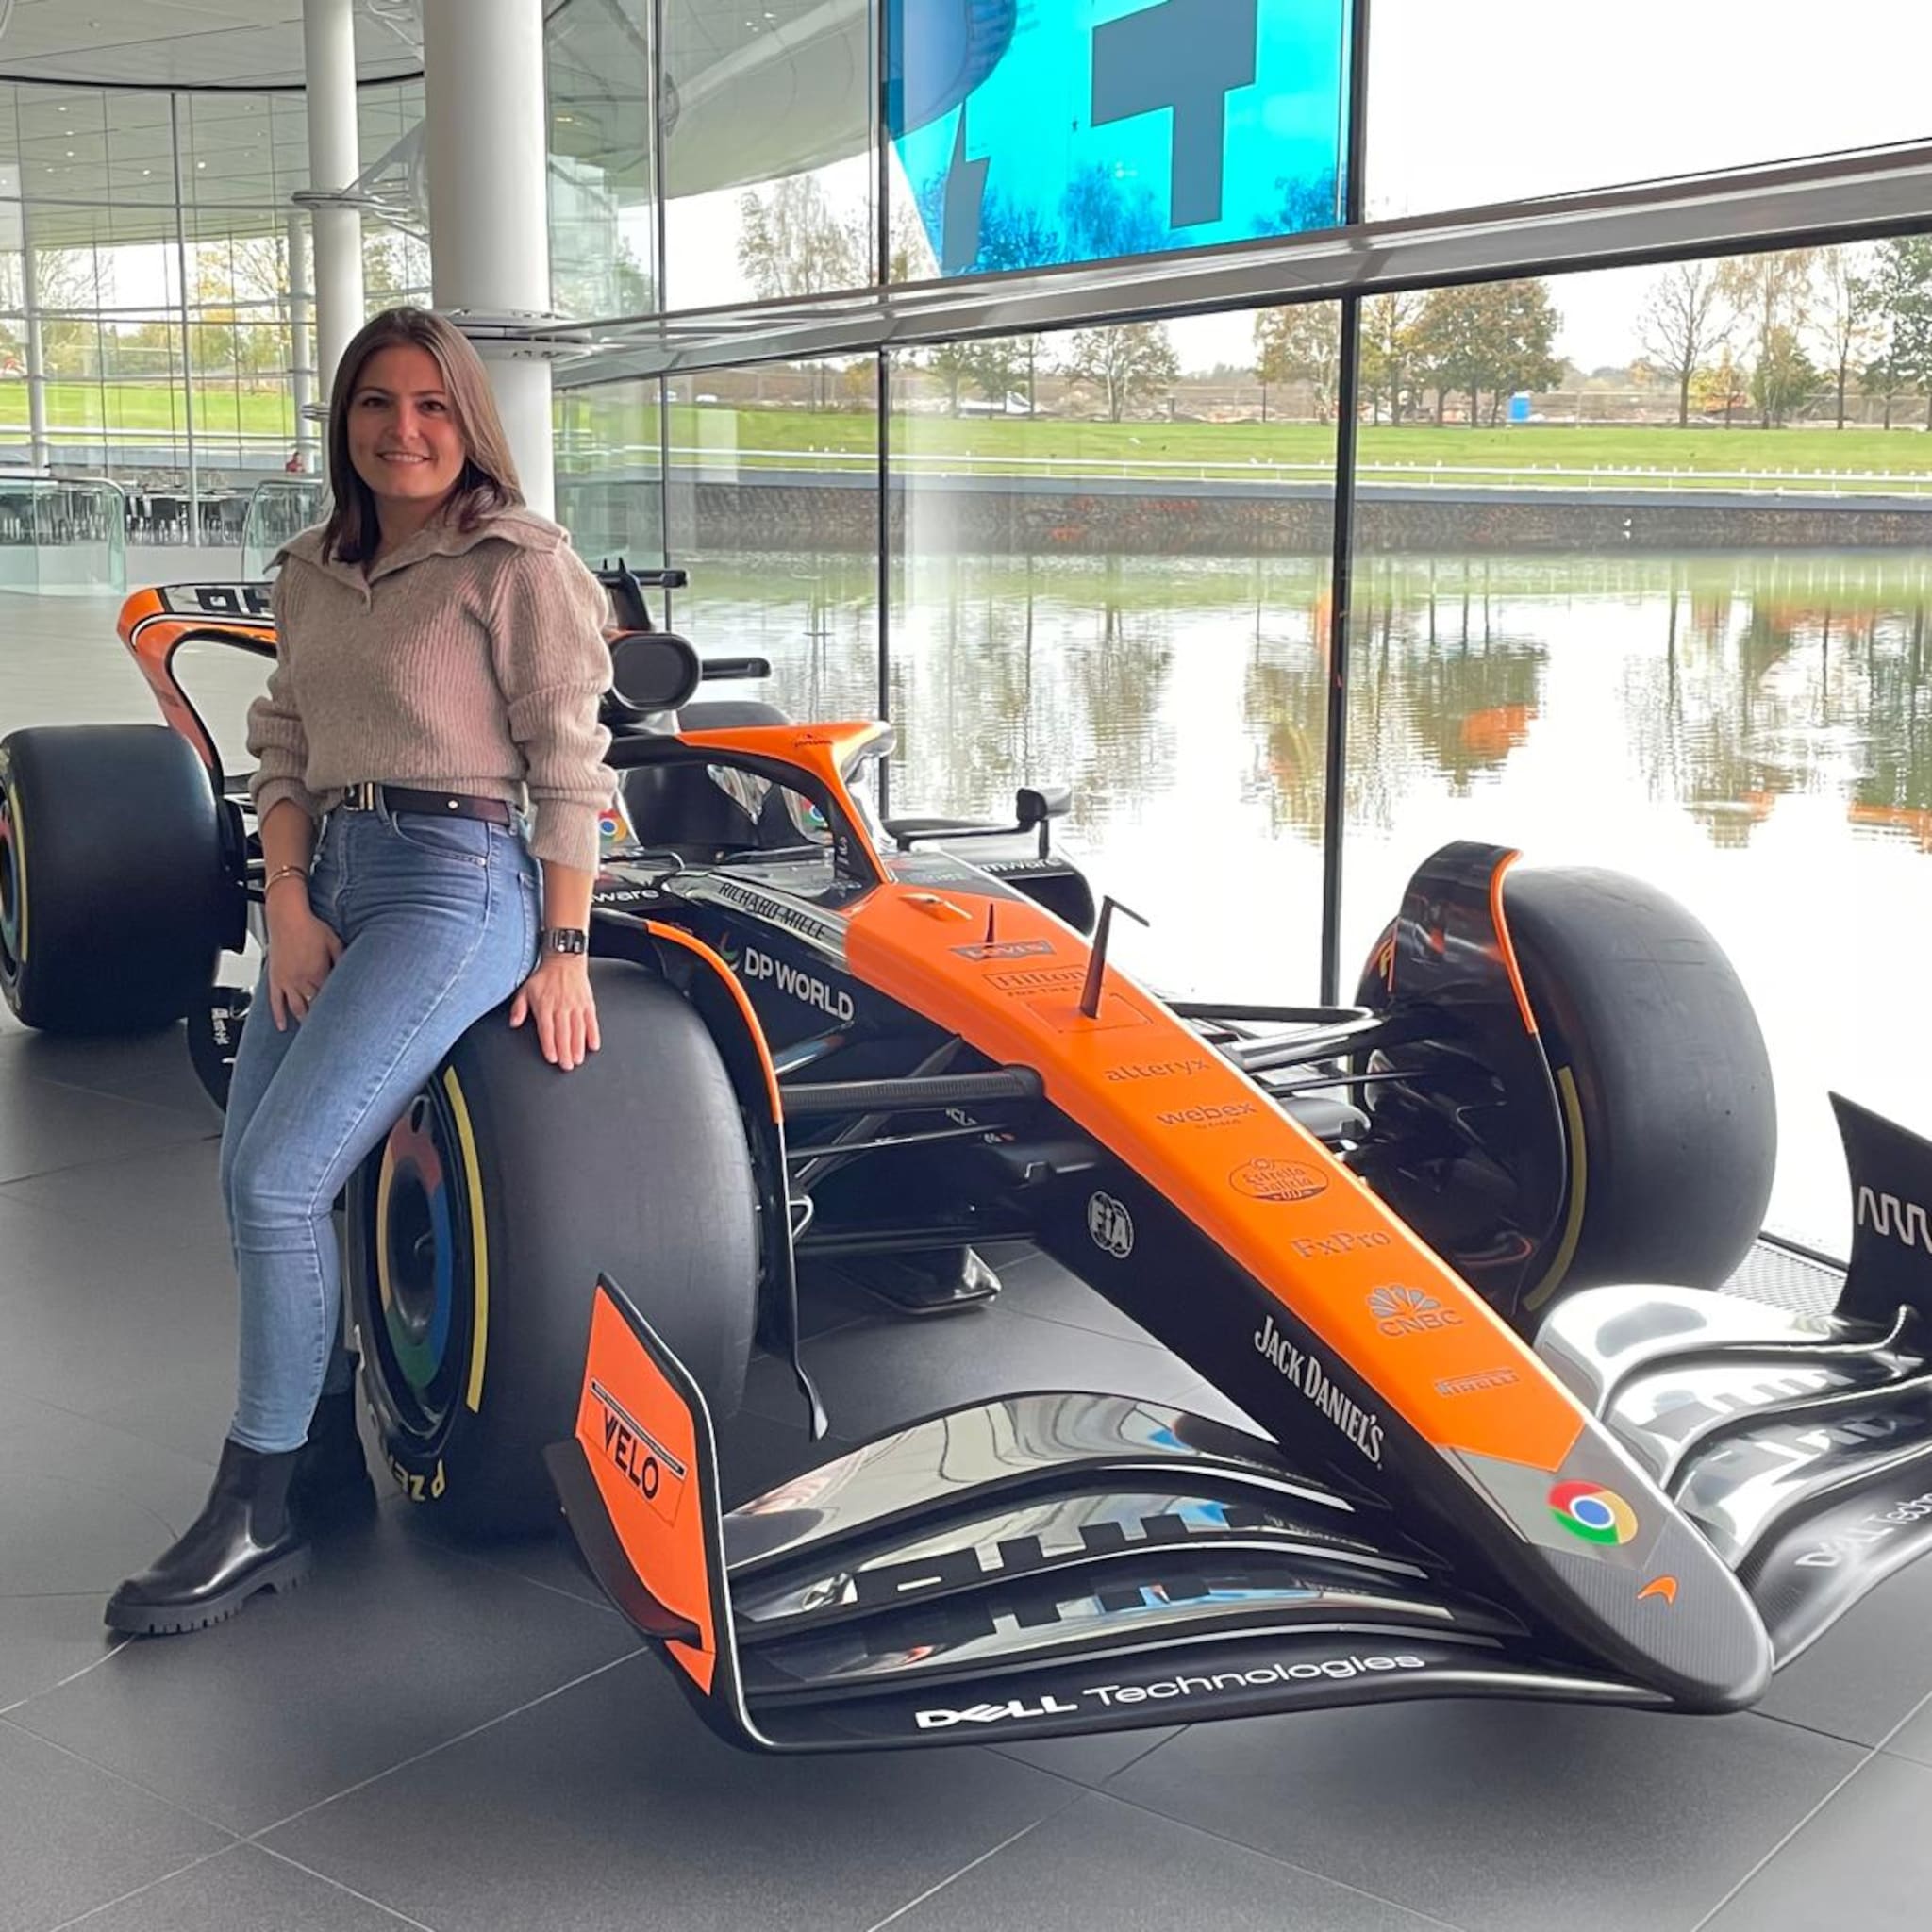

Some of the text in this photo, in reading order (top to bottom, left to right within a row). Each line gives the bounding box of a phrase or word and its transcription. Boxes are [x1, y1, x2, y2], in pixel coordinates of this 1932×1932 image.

[591, 889, 660, 903] ware
[718, 882, 825, 941] RICHARD MILLE
[744, 946, 855, 1021] DP WORLD
[996, 970, 1086, 988] Hilton
[1105, 1058, 1211, 1081] alteryx
[1156, 1102, 1258, 1124] webex
[1290, 1232, 1391, 1258] FxPro
[1379, 1309, 1464, 1337] CNBC
[1254, 1314, 1305, 1388] JACK
[603, 1407, 658, 1500] VELO
[915, 1656, 1425, 1729] DELL Technologies
